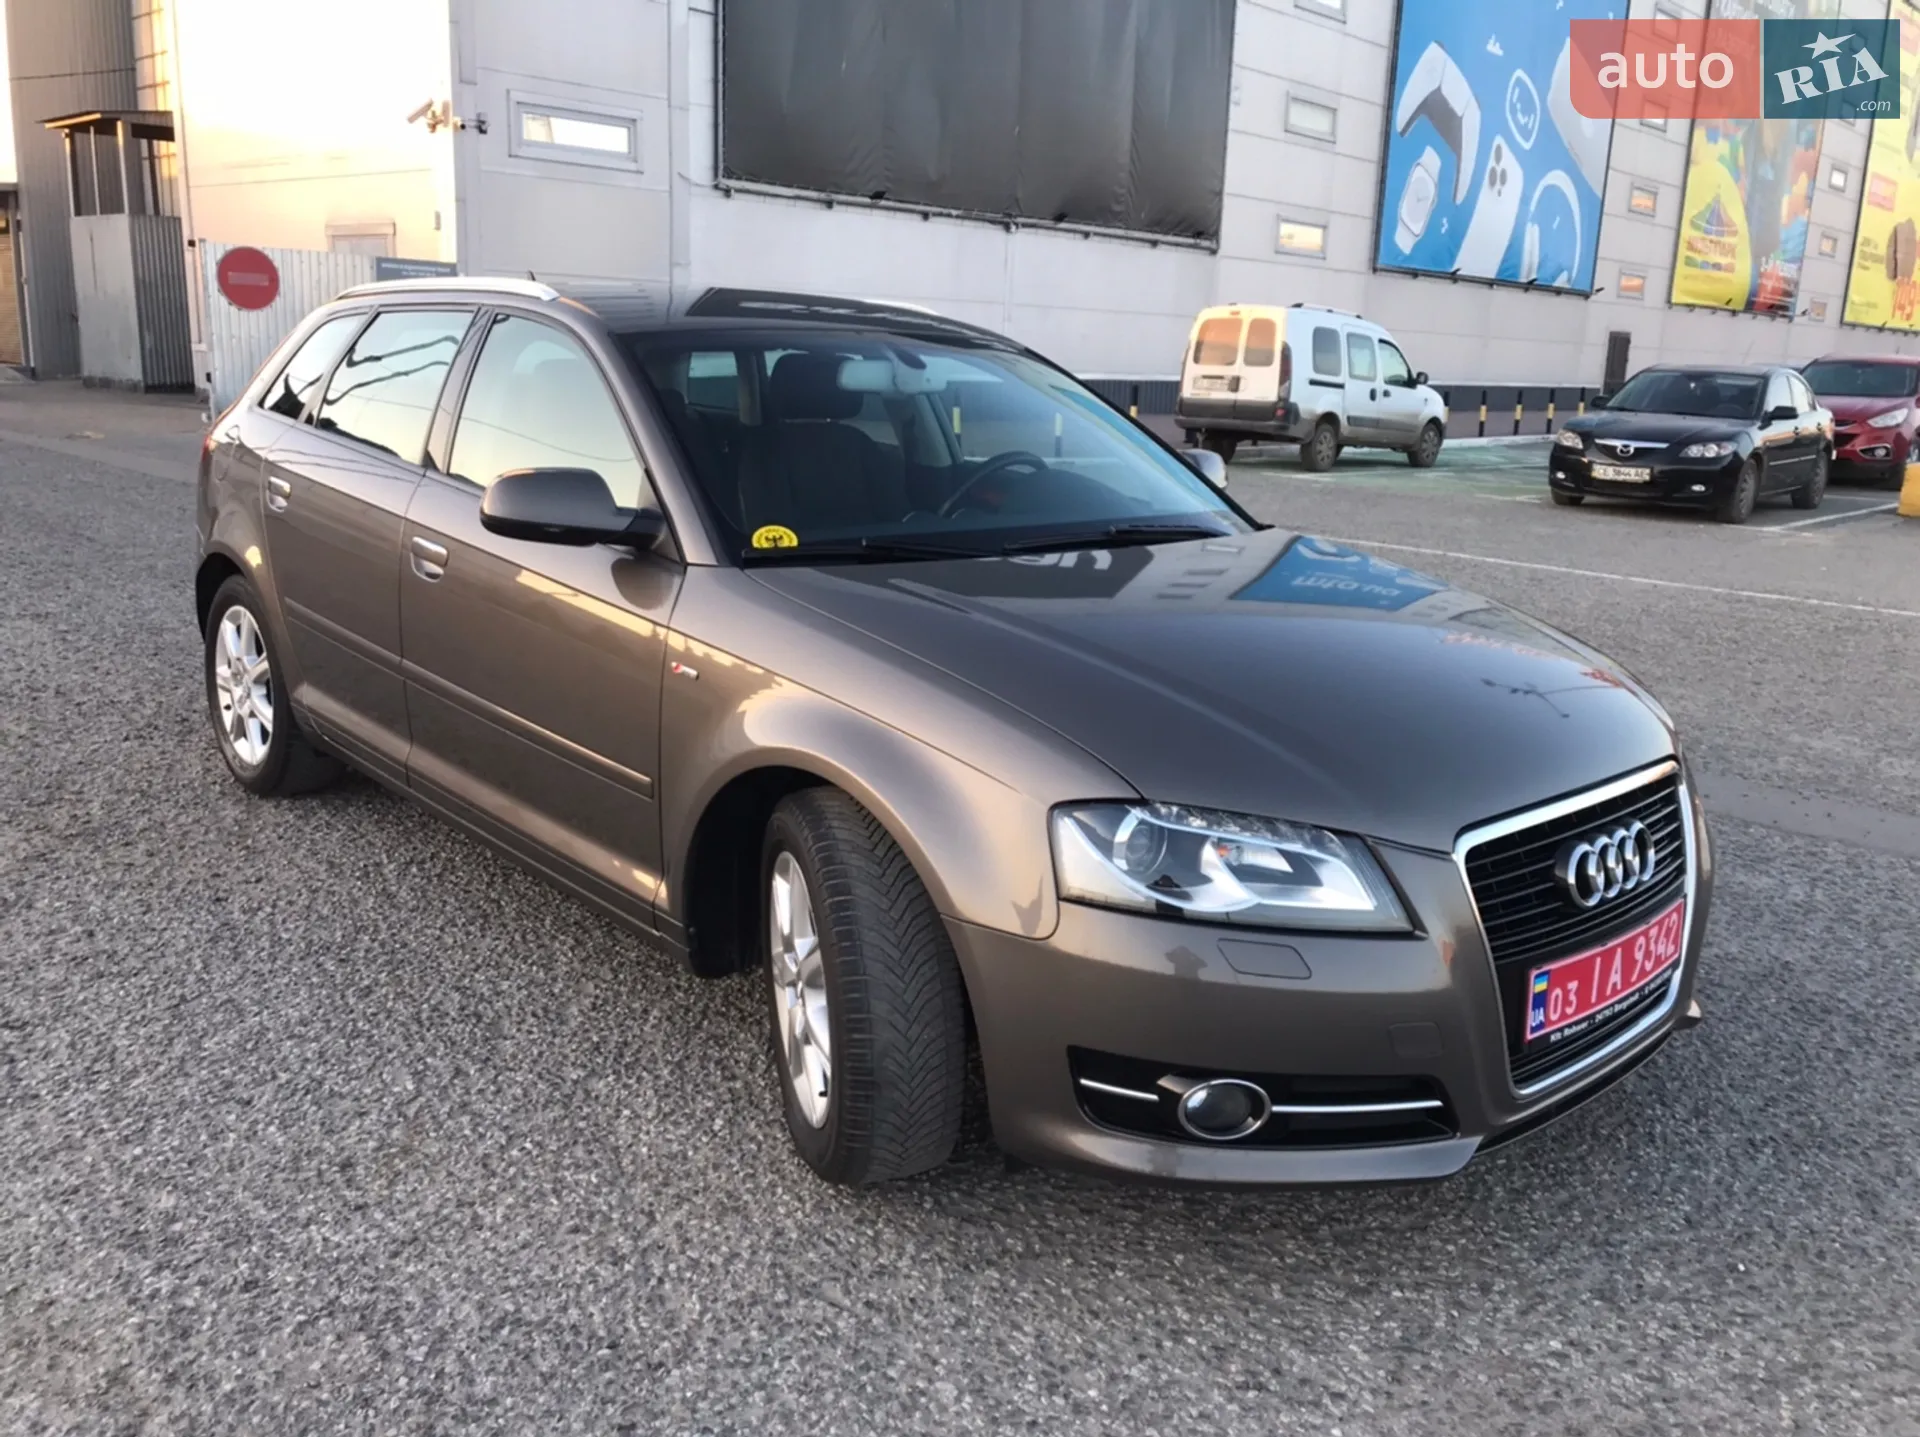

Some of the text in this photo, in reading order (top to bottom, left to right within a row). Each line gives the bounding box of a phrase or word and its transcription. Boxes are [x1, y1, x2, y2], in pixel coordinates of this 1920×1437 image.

[1550, 980, 1579, 1021] 03
[1591, 948, 1622, 1004] IA
[1631, 911, 1678, 983] 9342
[1531, 1008, 1545, 1027] UA
